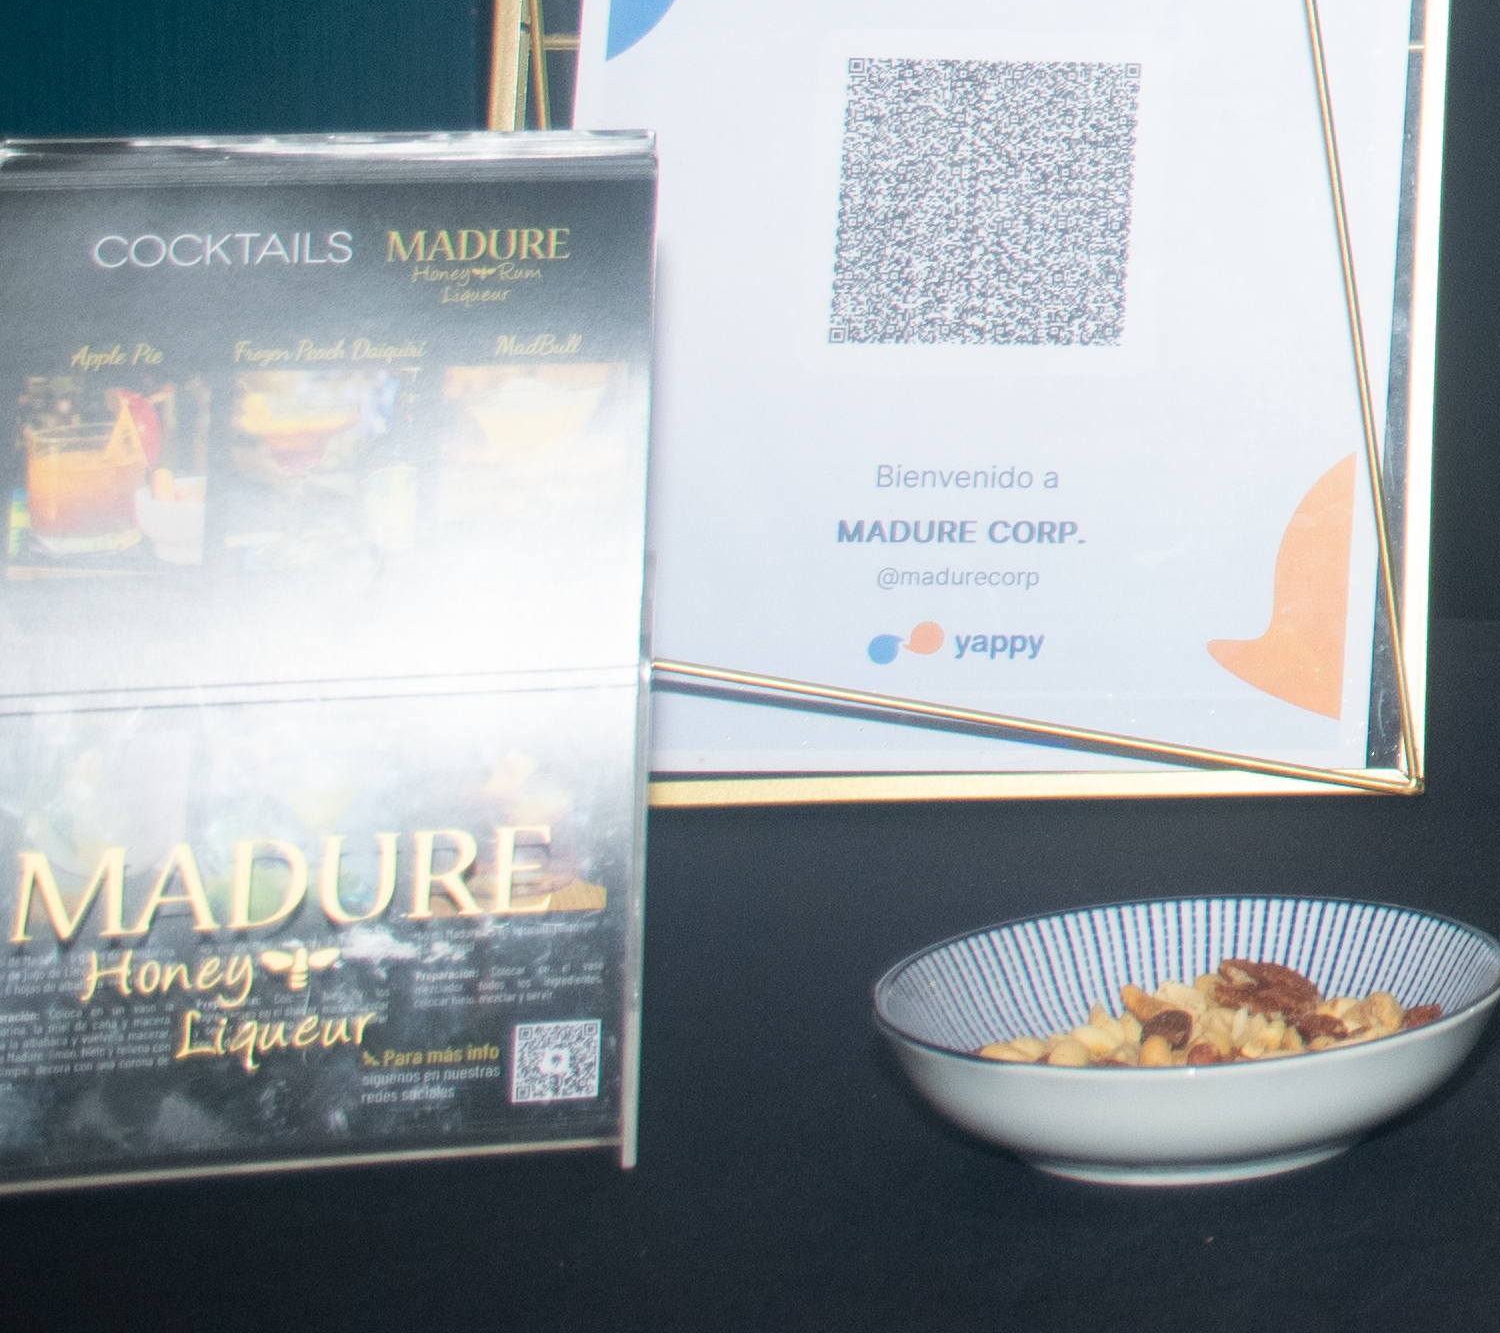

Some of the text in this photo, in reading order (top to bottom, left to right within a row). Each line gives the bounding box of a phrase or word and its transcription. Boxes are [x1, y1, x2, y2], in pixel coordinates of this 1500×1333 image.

[93, 230, 354, 269] COCKTAILS
[385, 227, 571, 262] MADURE
[411, 261, 543, 287] Honey Rum
[440, 286, 512, 308] Liqueur
[70, 342, 164, 372] Apple Pie
[232, 338, 428, 367] Frozen Peach Daiquiri
[494, 332, 584, 357] MadBull
[875, 463, 1061, 490] Bienvenido a
[836, 518, 1087, 545] MADURE CORP.
[876, 566, 1041, 591] @madurecorp
[953, 633, 1046, 660] yappy
[10, 824, 553, 942] MADURE
[80, 946, 256, 1009] Honey
[175, 1007, 377, 1076] Liqueur
[382, 1042, 501, 1068] Para más info
[423, 1069, 441, 1085] en
[443, 1065, 502, 1081] nuestras
[360, 1085, 457, 1105] redes sociales
